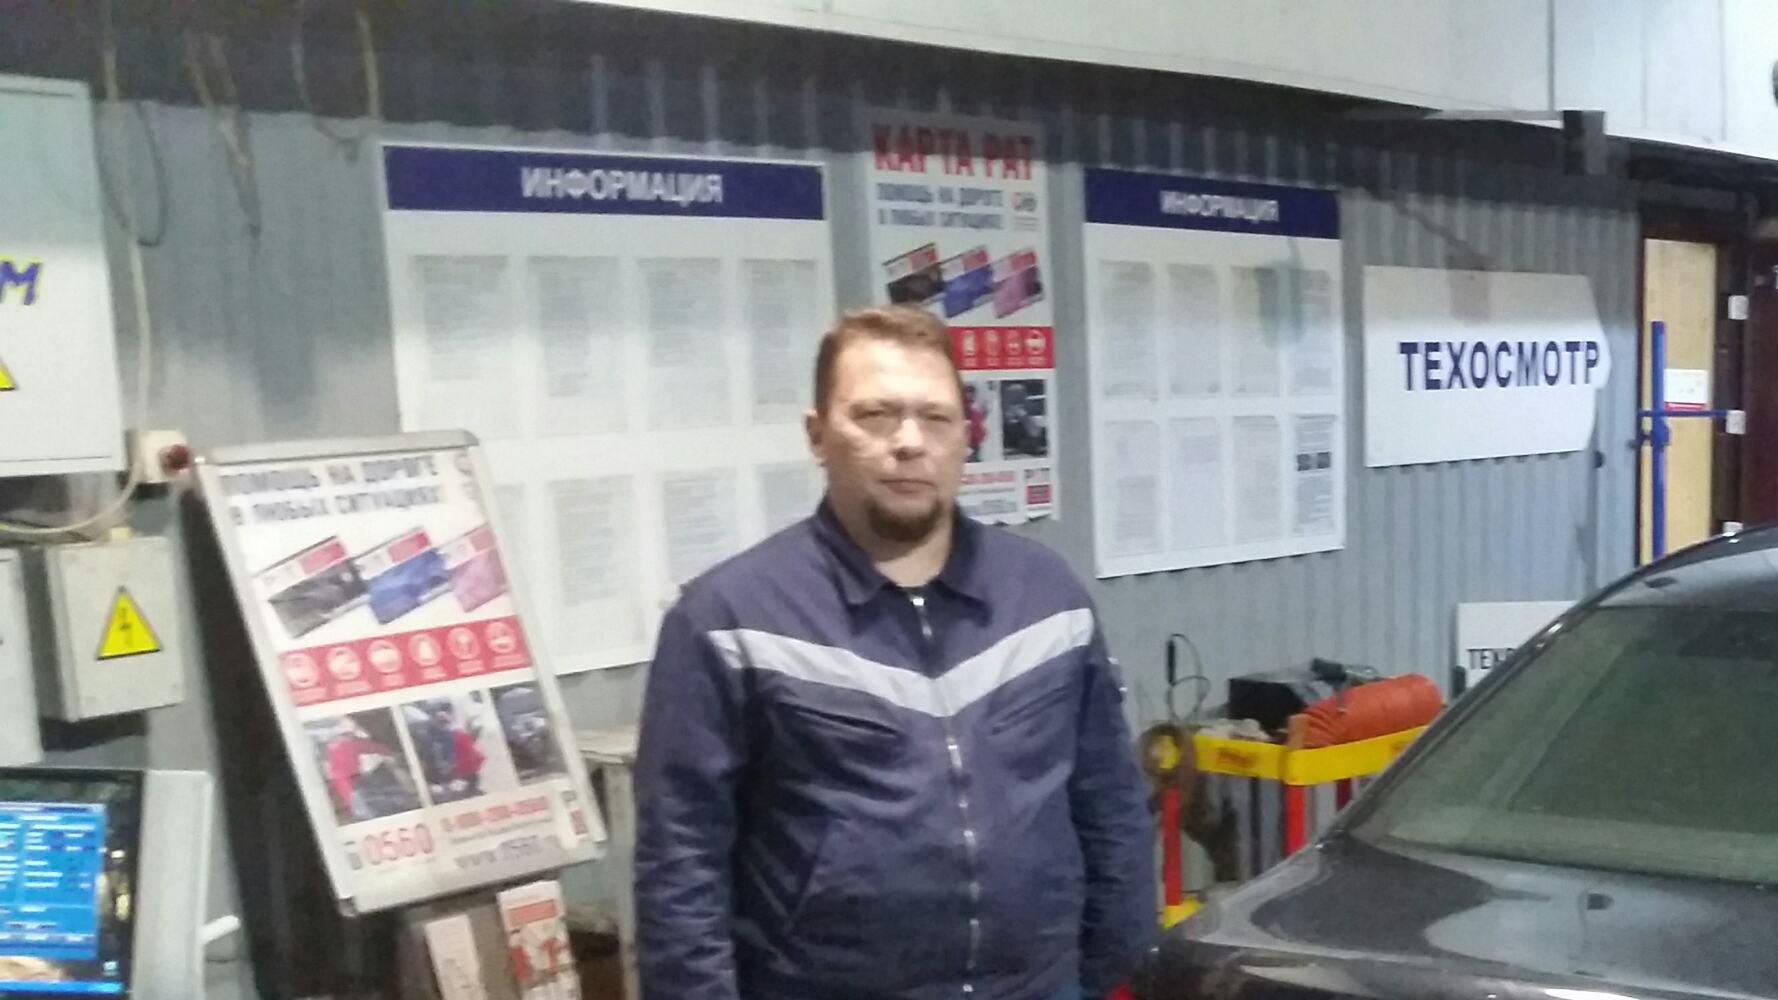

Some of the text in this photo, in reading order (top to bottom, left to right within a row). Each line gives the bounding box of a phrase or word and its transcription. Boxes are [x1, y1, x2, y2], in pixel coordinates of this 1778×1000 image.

[872, 122, 1034, 180] КАРТА РАТ
[521, 167, 723, 207] ИНФОРМАЦИЯ
[1399, 341, 1600, 391] ТЕХОСМОТР
